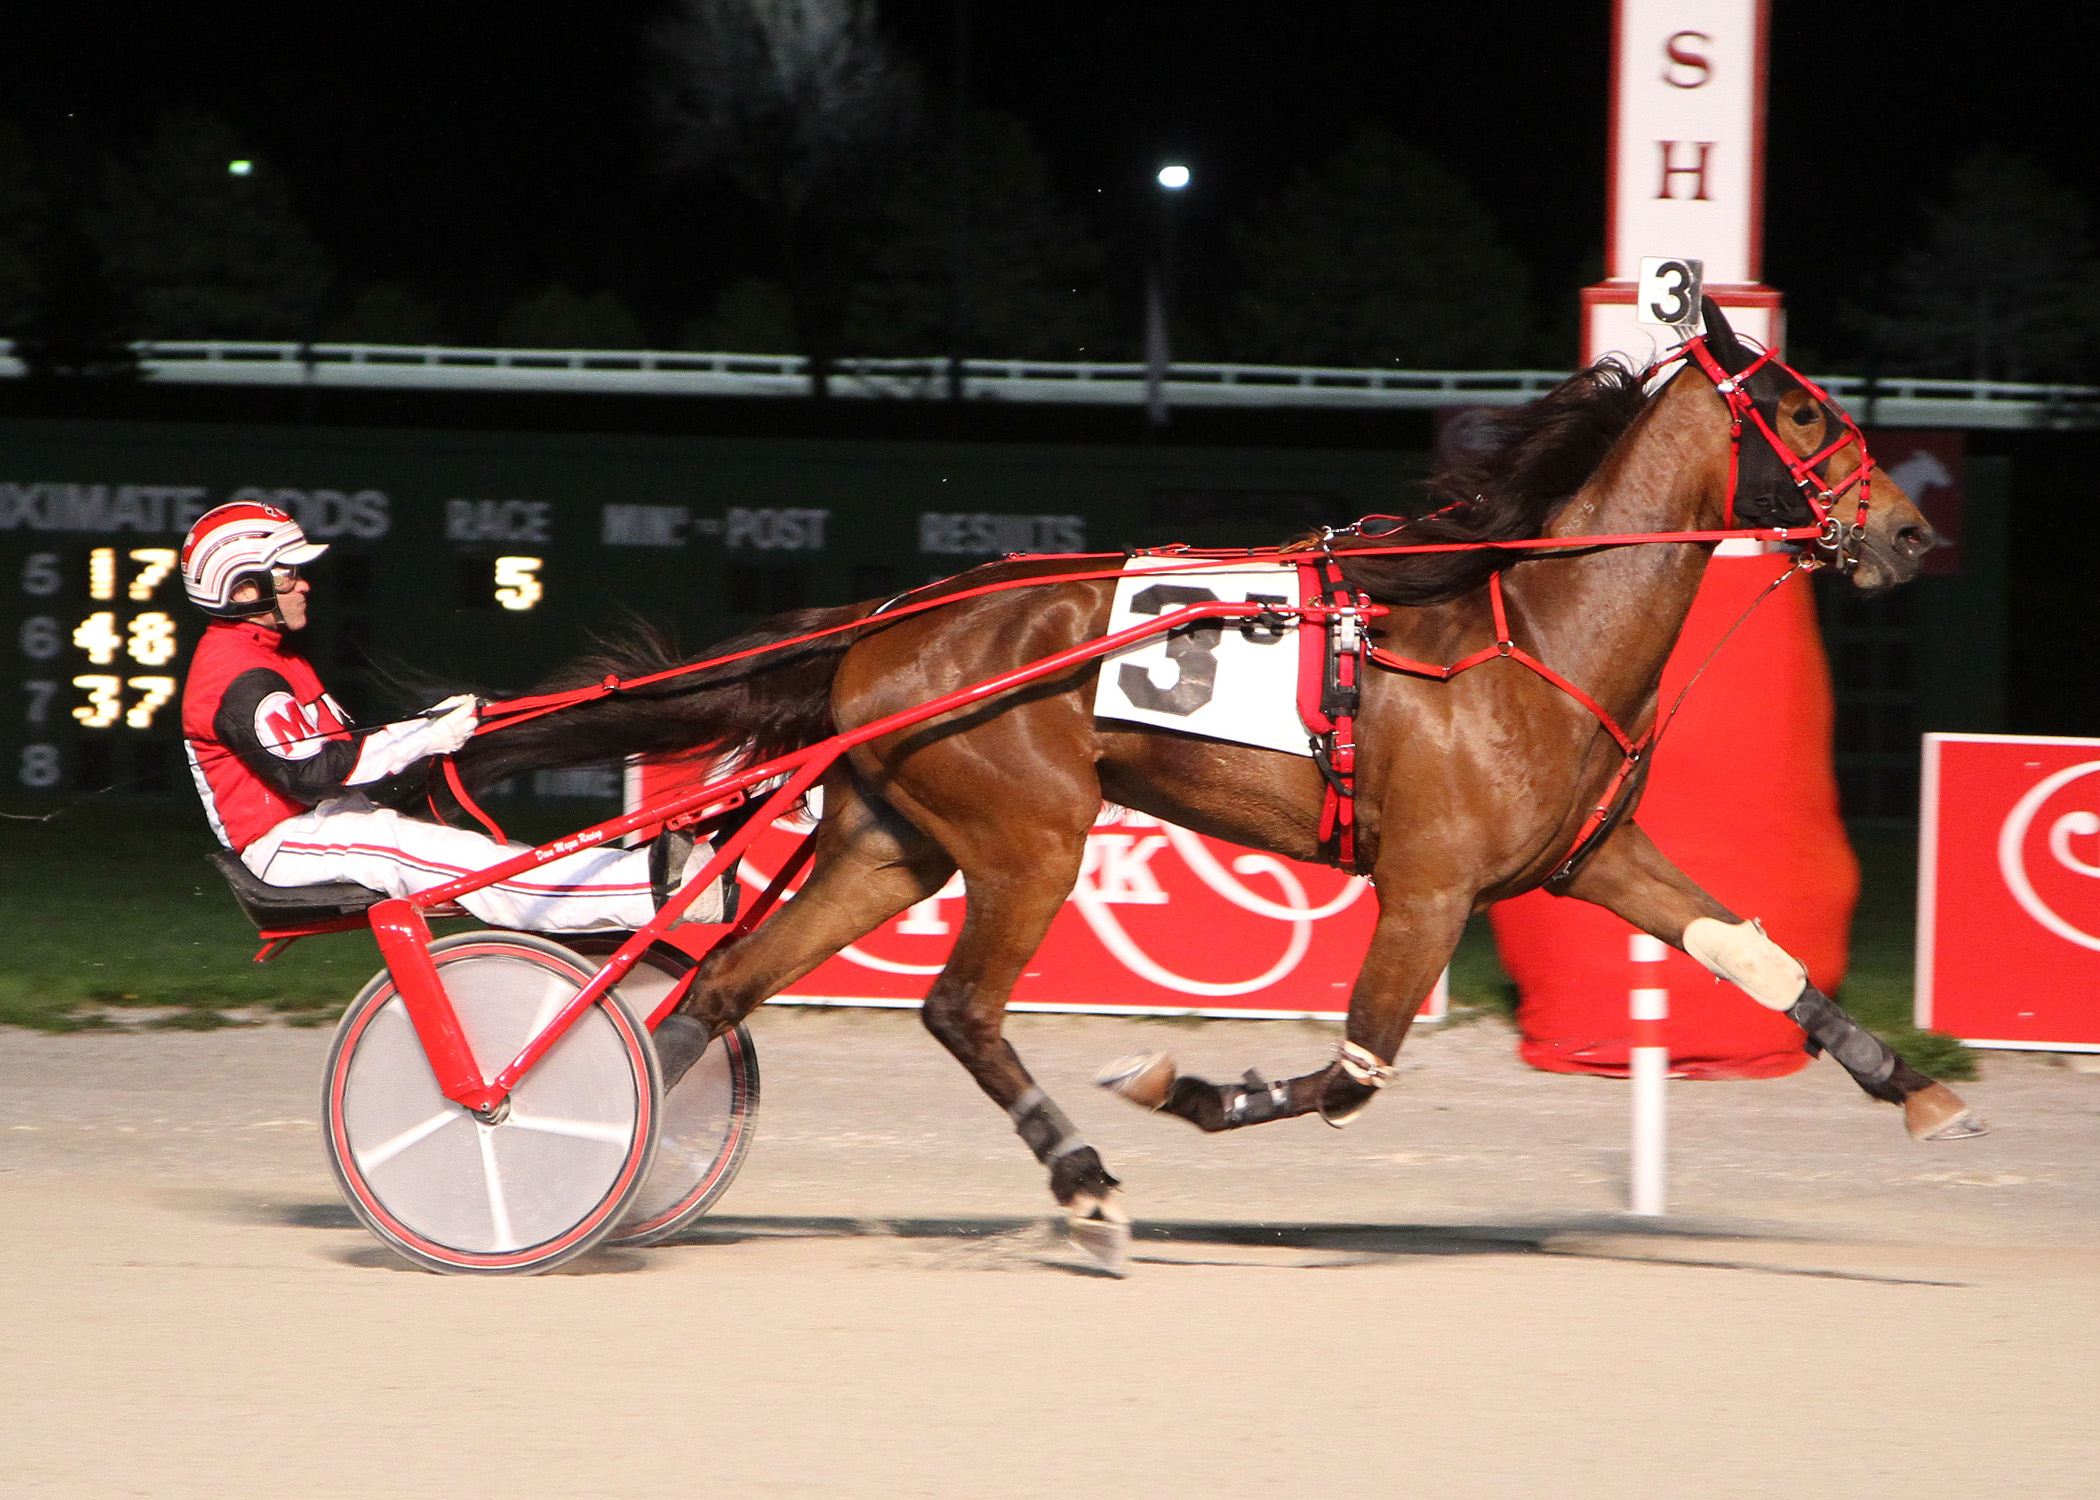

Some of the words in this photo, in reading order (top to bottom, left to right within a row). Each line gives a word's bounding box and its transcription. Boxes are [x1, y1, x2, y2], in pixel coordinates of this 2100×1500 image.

[1651, 261, 1690, 323] 3
[446, 498, 551, 543] RACE
[725, 507, 831, 551] POST
[919, 512, 1085, 552] RESULTS
[23, 552, 61, 596] 5
[90, 547, 178, 601] 17
[494, 555, 543, 611] 5
[21, 614, 62, 660] 6
[72, 610, 177, 666] 48
[1117, 583, 1222, 717] 3
[24, 679, 58, 723] 7
[72, 673, 177, 729] 37
[264, 698, 317, 756] M
[20, 743, 61, 787] 8
